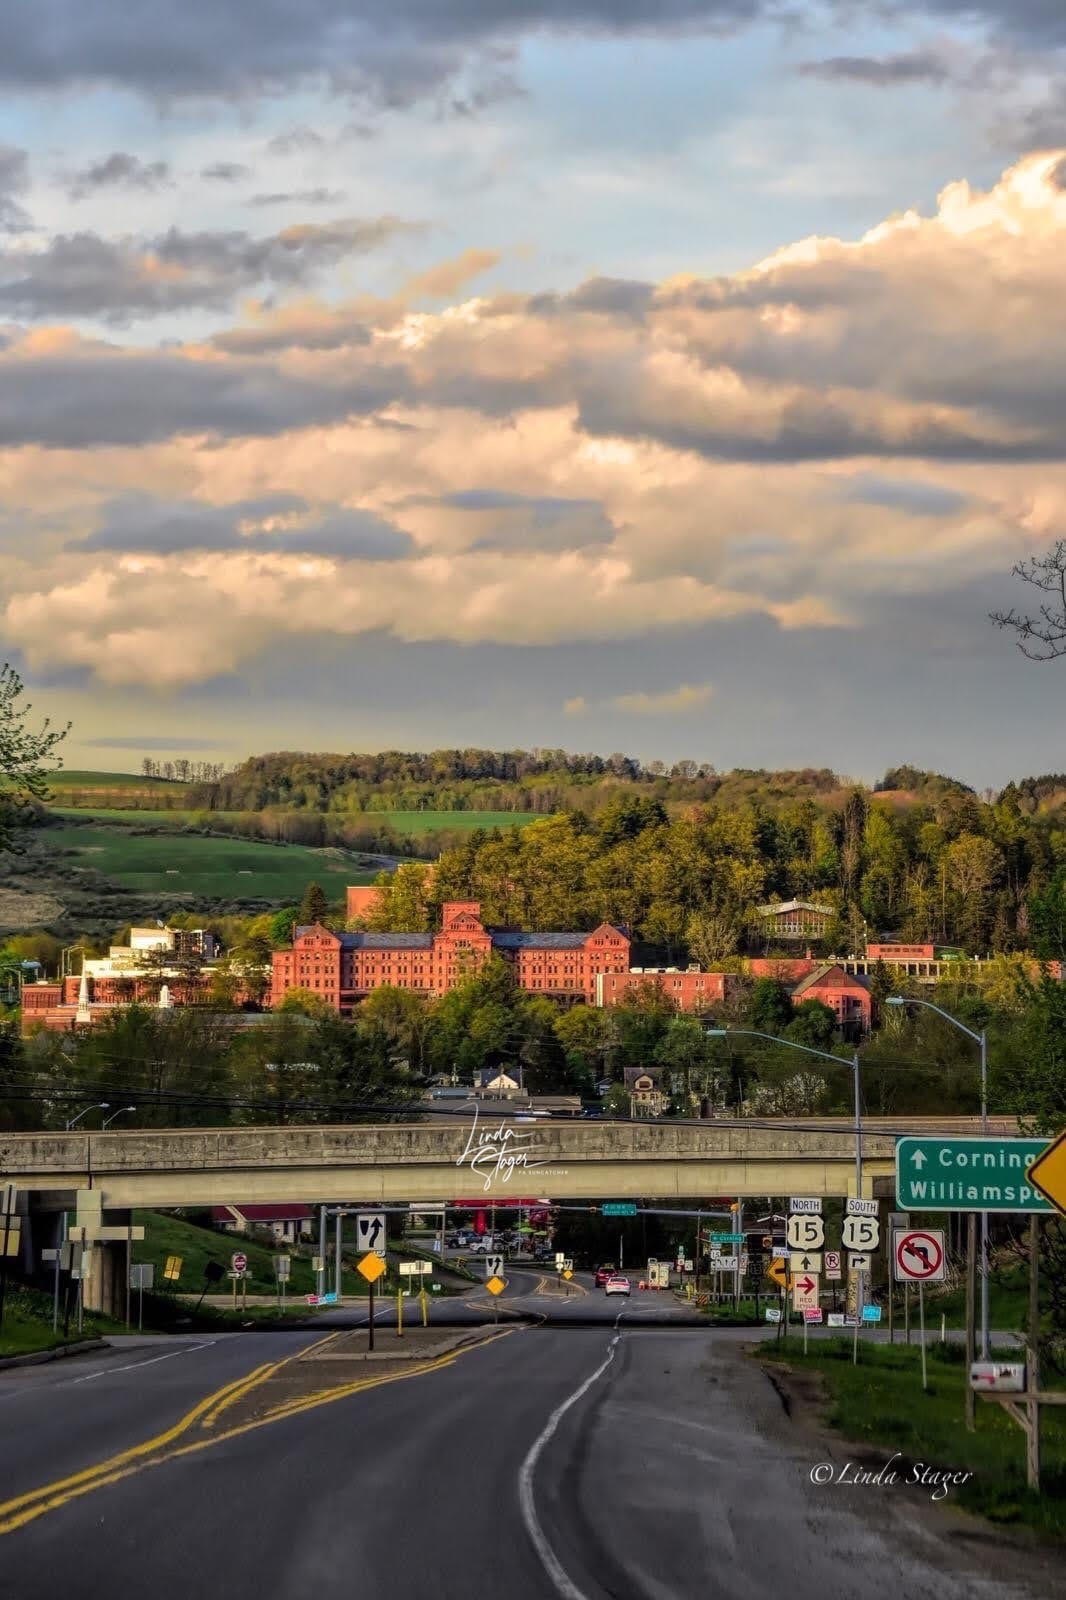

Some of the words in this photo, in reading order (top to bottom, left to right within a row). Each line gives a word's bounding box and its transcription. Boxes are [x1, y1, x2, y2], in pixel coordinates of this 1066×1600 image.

[910, 1180, 1046, 1204] Williamspo
[792, 1200, 820, 1211] NORTH
[849, 1200, 876, 1212] SOUTH
[794, 1221, 818, 1242] 15
[850, 1222, 873, 1243] 15
